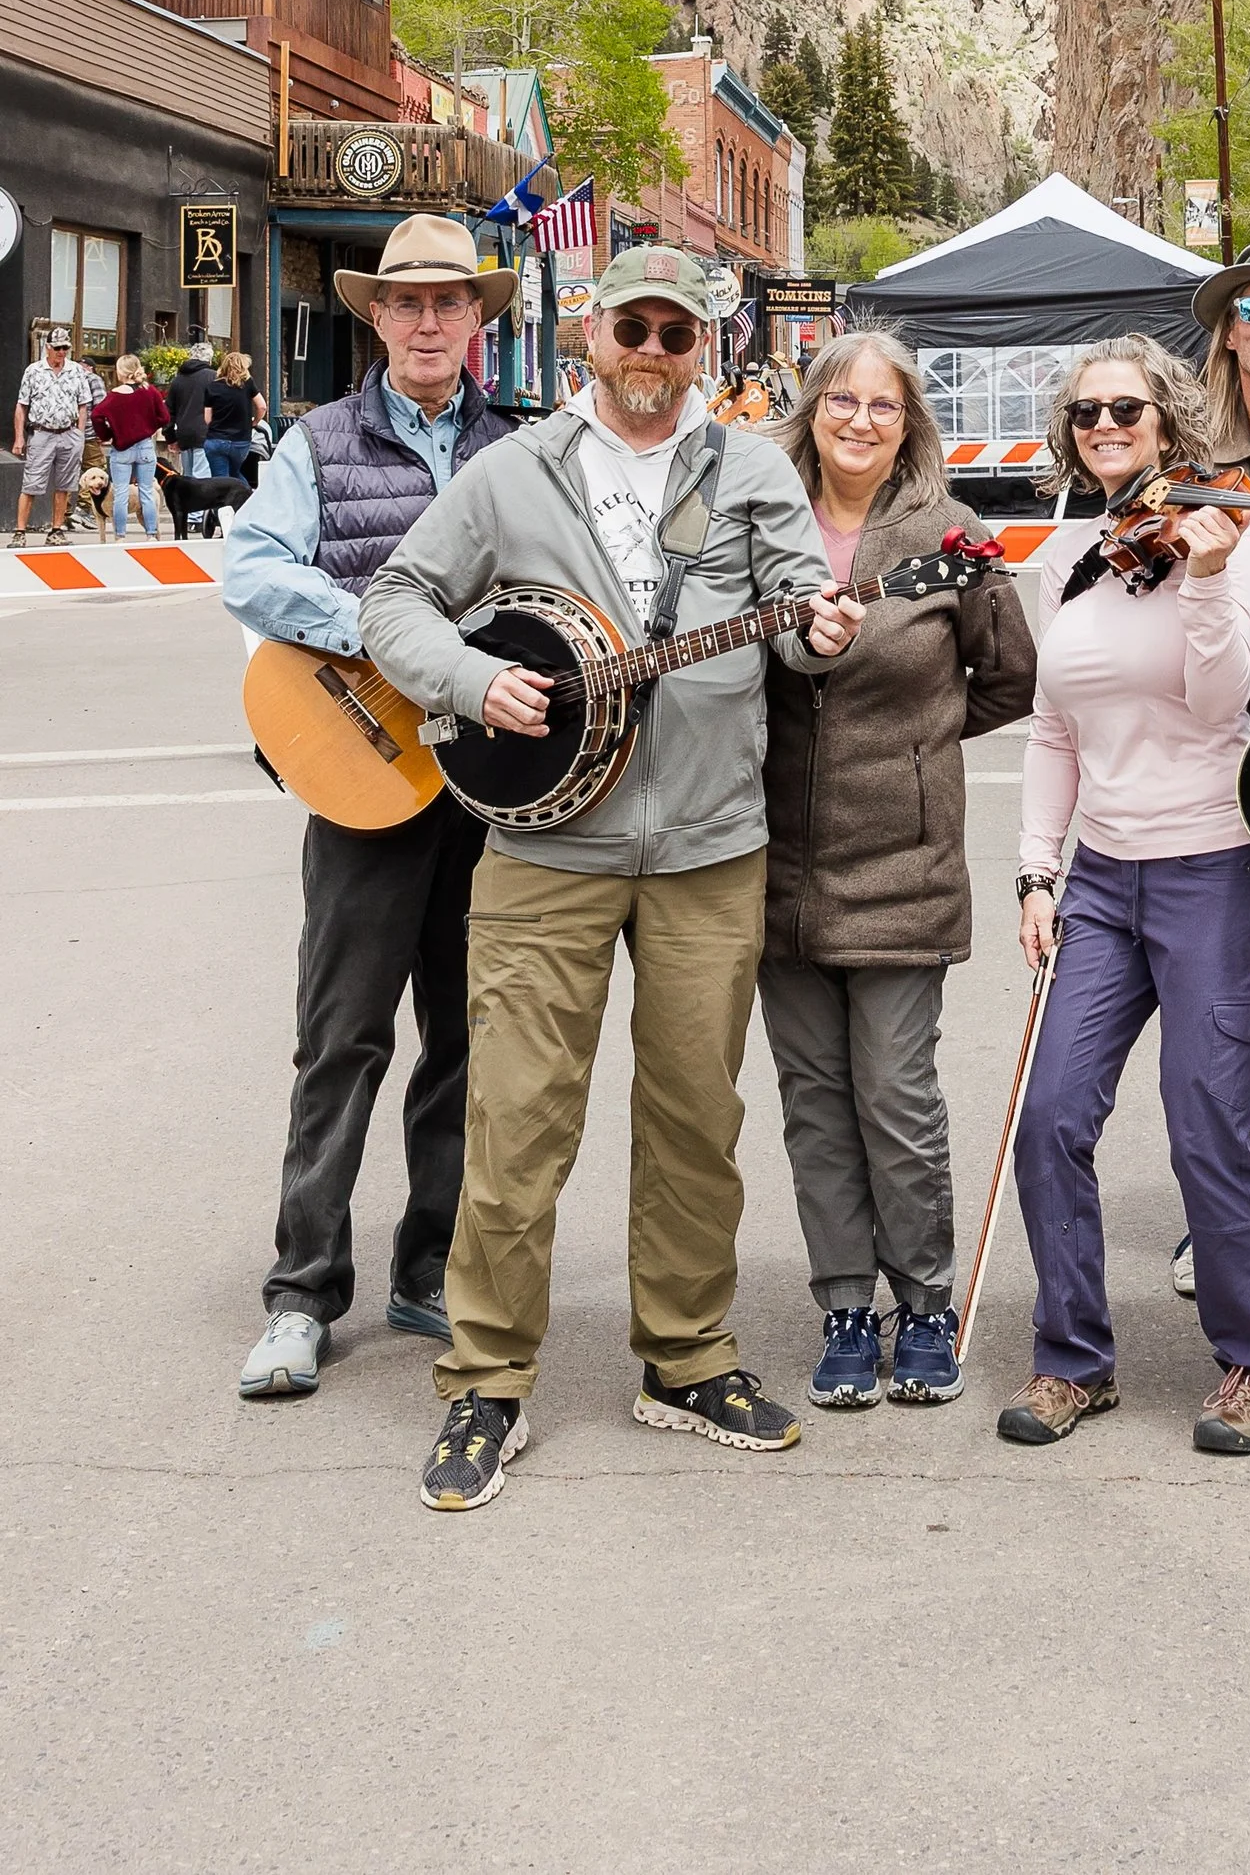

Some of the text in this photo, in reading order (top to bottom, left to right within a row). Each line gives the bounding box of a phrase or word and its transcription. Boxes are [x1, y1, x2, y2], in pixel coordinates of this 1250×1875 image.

[342, 137, 395, 166] OLD MINERS INN
[348, 175, 373, 189] CREEDE
[188, 210, 211, 218] Broken
[766, 289, 832, 302] TOMKINS
